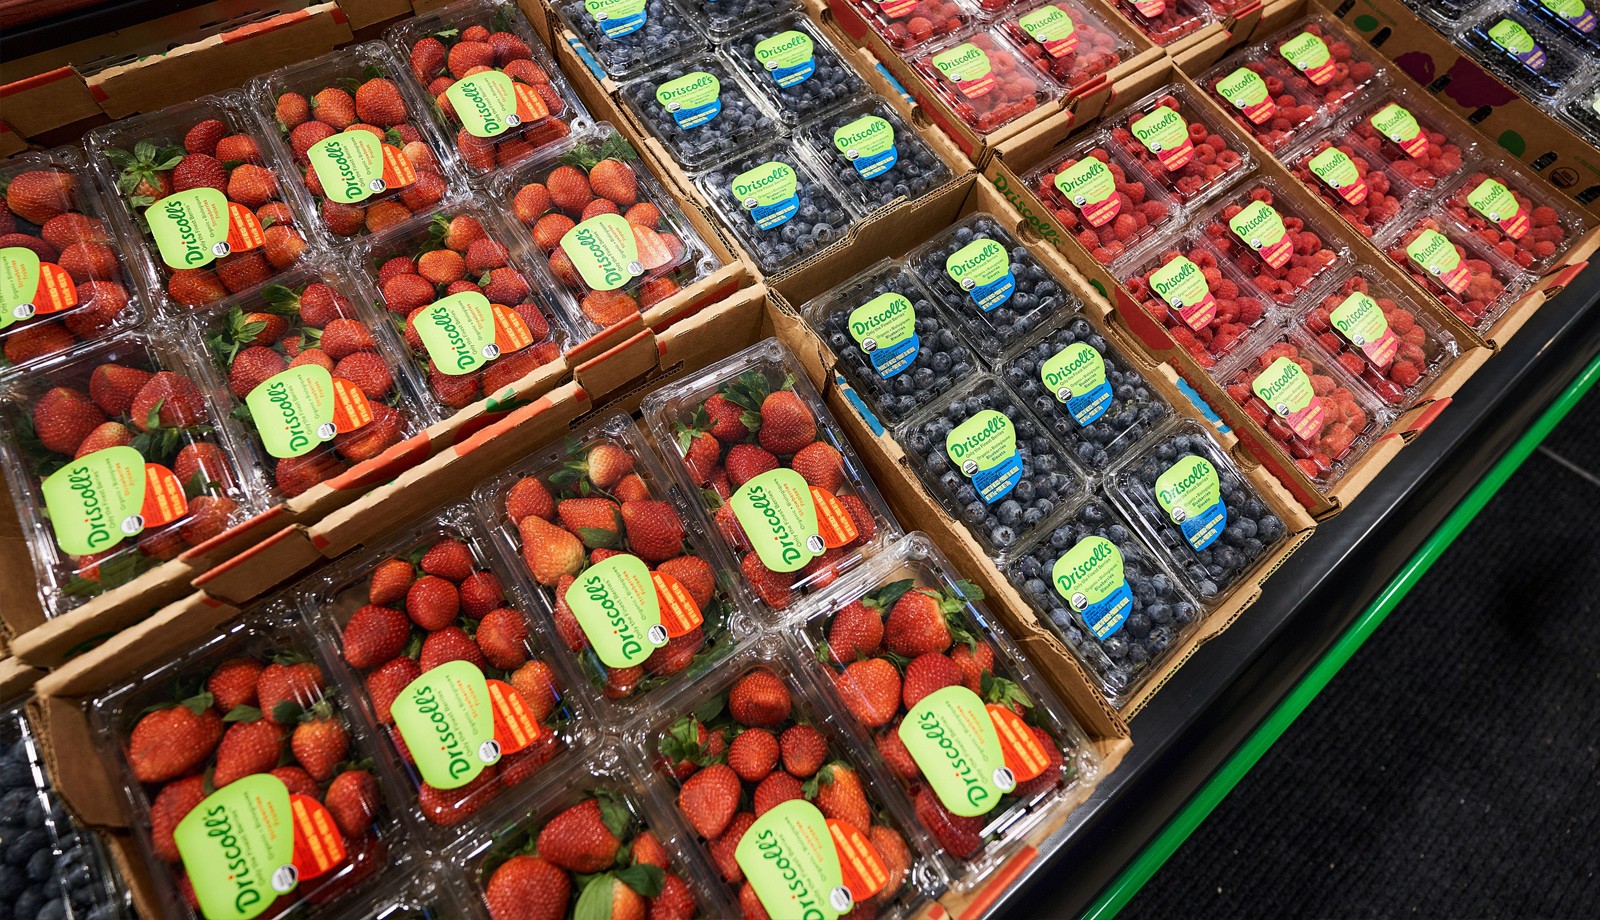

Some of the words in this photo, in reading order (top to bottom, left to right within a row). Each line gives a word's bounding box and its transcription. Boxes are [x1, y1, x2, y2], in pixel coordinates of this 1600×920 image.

[1025, 10, 1063, 32] Driscoll's
[758, 35, 807, 59] Driscoll's
[938, 48, 981, 71] Driscoll's
[660, 76, 713, 100] Driscoll's
[1223, 73, 1256, 98] Driscoll's
[461, 81, 499, 133] Driscoll's
[837, 121, 887, 147] Driscoll's
[1137, 112, 1177, 139] Driscoll's
[325, 141, 362, 199] Driscoll's
[735, 166, 790, 196] Driscoll's
[1060, 163, 1104, 192] Driscoll's
[993, 171, 1061, 248] Driscoll's
[1236, 206, 1272, 236] Driscoll's
[165, 200, 203, 264] Driscoll's
[575, 227, 621, 284] Driscoll's
[950, 243, 1000, 276] Driscoll's
[1156, 262, 1195, 294] Driscoll's
[852, 298, 908, 335] Driscoll's
[1337, 298, 1372, 331] Driscoll's
[431, 306, 474, 369] Driscoll's
[1045, 348, 1095, 385] Driscoll's
[1260, 363, 1298, 400] Driscoll's
[1168, 357, 1234, 426] Raspberries
[266, 382, 308, 452] Driscoll's
[950, 415, 1006, 457] Driscoll's
[792, 488, 805, 506] Fraises
[1159, 461, 1210, 504] Driscoll's
[70, 465, 109, 547] Driscoll's
[767, 491, 780, 508] Berries
[783, 483, 805, 516] Strawberries
[747, 485, 800, 565] Driscoll's
[777, 509, 789, 525] Finest
[786, 525, 795, 535] the
[792, 534, 802, 547] Only
[1057, 542, 1112, 590] Driscoll's
[605, 580, 619, 599] Berries
[622, 570, 645, 605] Strawberries
[632, 575, 646, 595] Fraises
[584, 575, 641, 660] Driscoll's
[616, 600, 629, 617] Finest
[626, 617, 635, 627] the
[632, 626, 643, 640] Only
[413, 684, 470, 779] Driscoll's
[917, 709, 987, 807] Driscoll's
[203, 803, 260, 913] Driscoll's
